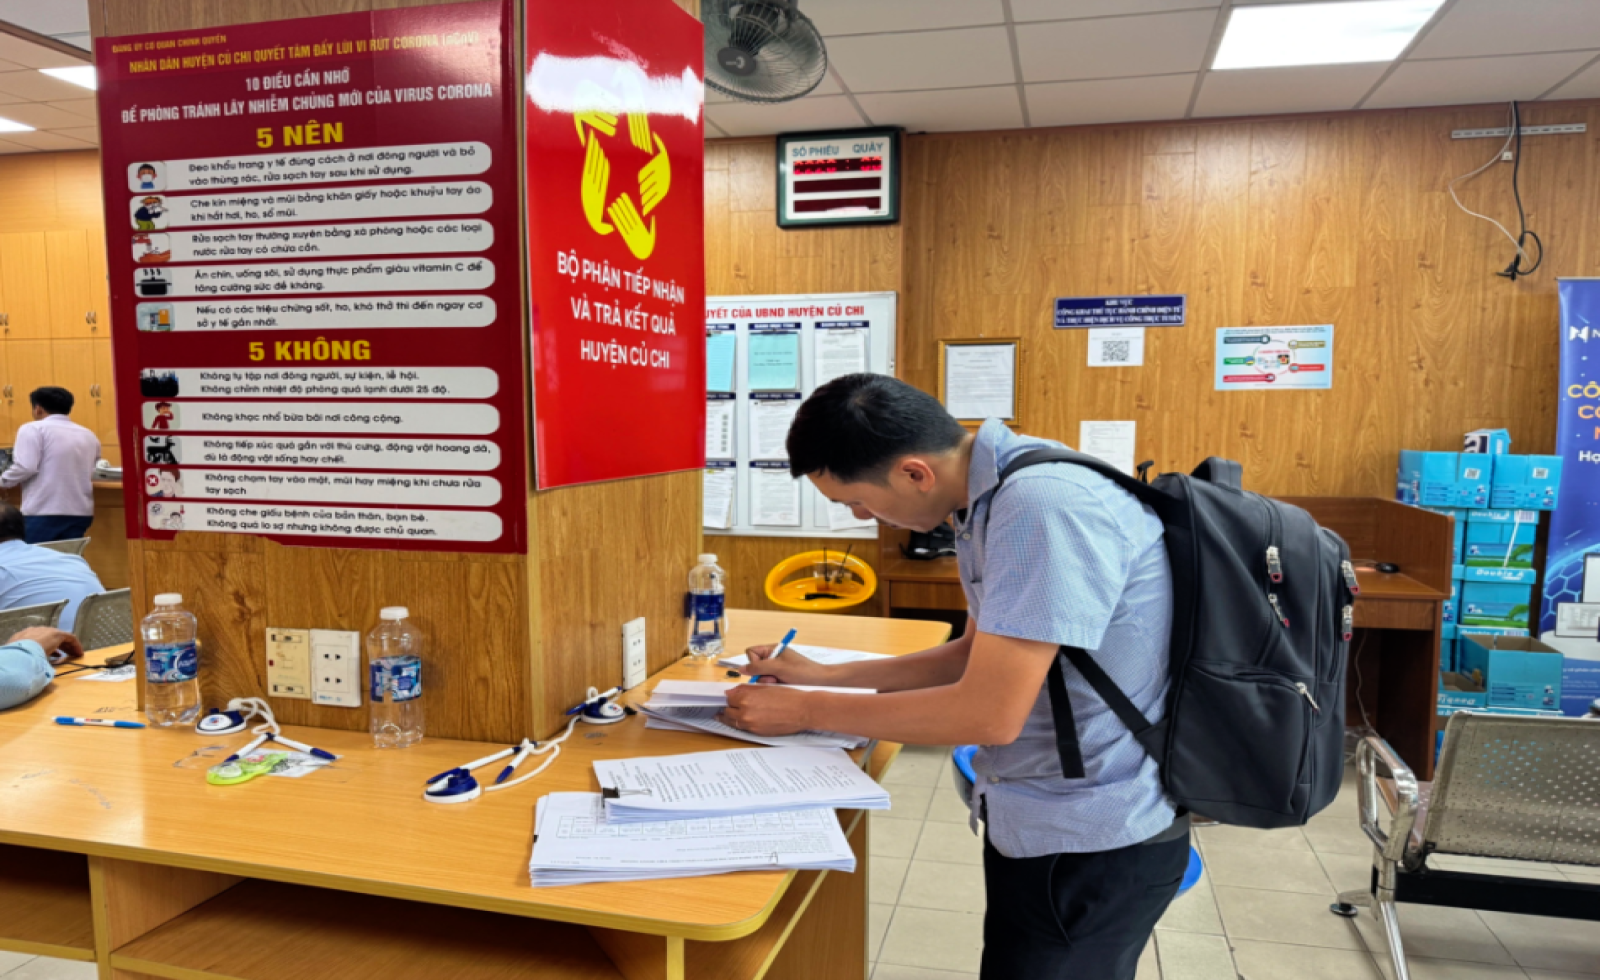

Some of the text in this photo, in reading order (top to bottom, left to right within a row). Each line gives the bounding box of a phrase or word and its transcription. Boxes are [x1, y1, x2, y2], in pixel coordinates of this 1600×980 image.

[390, 34, 438, 49] CORONA
[246, 68, 349, 91] 10 ĐIỀU CẦN NHỚ
[121, 79, 494, 123] ĐỂ PHÒNG TRÁNH LÂY NHIỄM CHỦNG MỚI CỦA VIRUS CORONA
[257, 118, 343, 148] 5 NÊN
[792, 146, 806, 157] SỐ
[810, 144, 840, 156] PHIẾU
[557, 248, 684, 308] BỘ PHẬN TIẾP NHẬN
[570, 293, 676, 336] VÀ TRẢ KẾT QUẢ
[731, 306, 752, 318] CỦA
[756, 307, 785, 318] UBND
[788, 304, 824, 318] HUYỆN
[827, 303, 842, 316] CỦ
[845, 305, 864, 316] CHI
[249, 336, 371, 360] 5 KHÔNG
[580, 338, 670, 370] HUYỆN CỦ CHI
